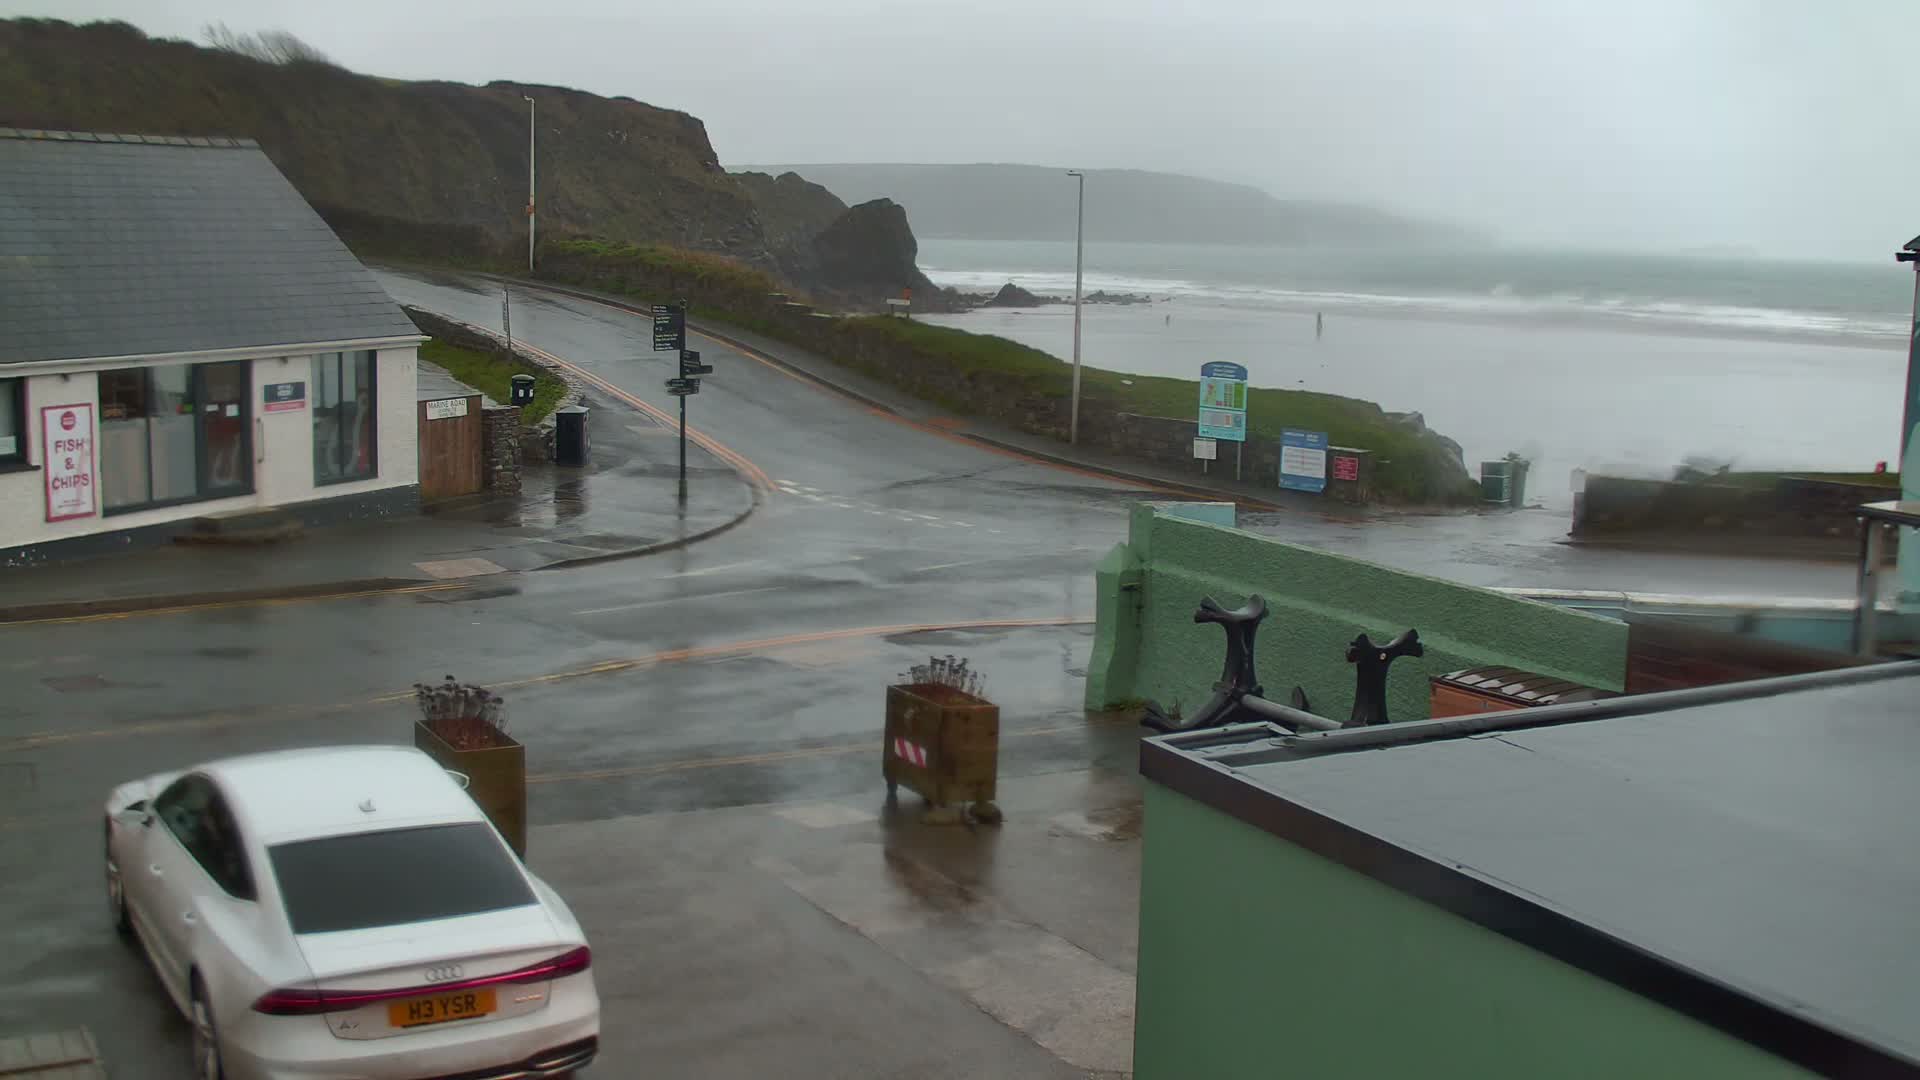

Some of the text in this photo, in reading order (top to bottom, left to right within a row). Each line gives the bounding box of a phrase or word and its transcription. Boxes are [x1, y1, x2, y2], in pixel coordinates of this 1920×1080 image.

[428, 401, 449, 409] MARINE
[54, 439, 85, 454] FISH
[65, 457, 75, 470] &
[51, 473, 90, 491] CHIPS
[408, 994, 477, 1021] H3 YSR
